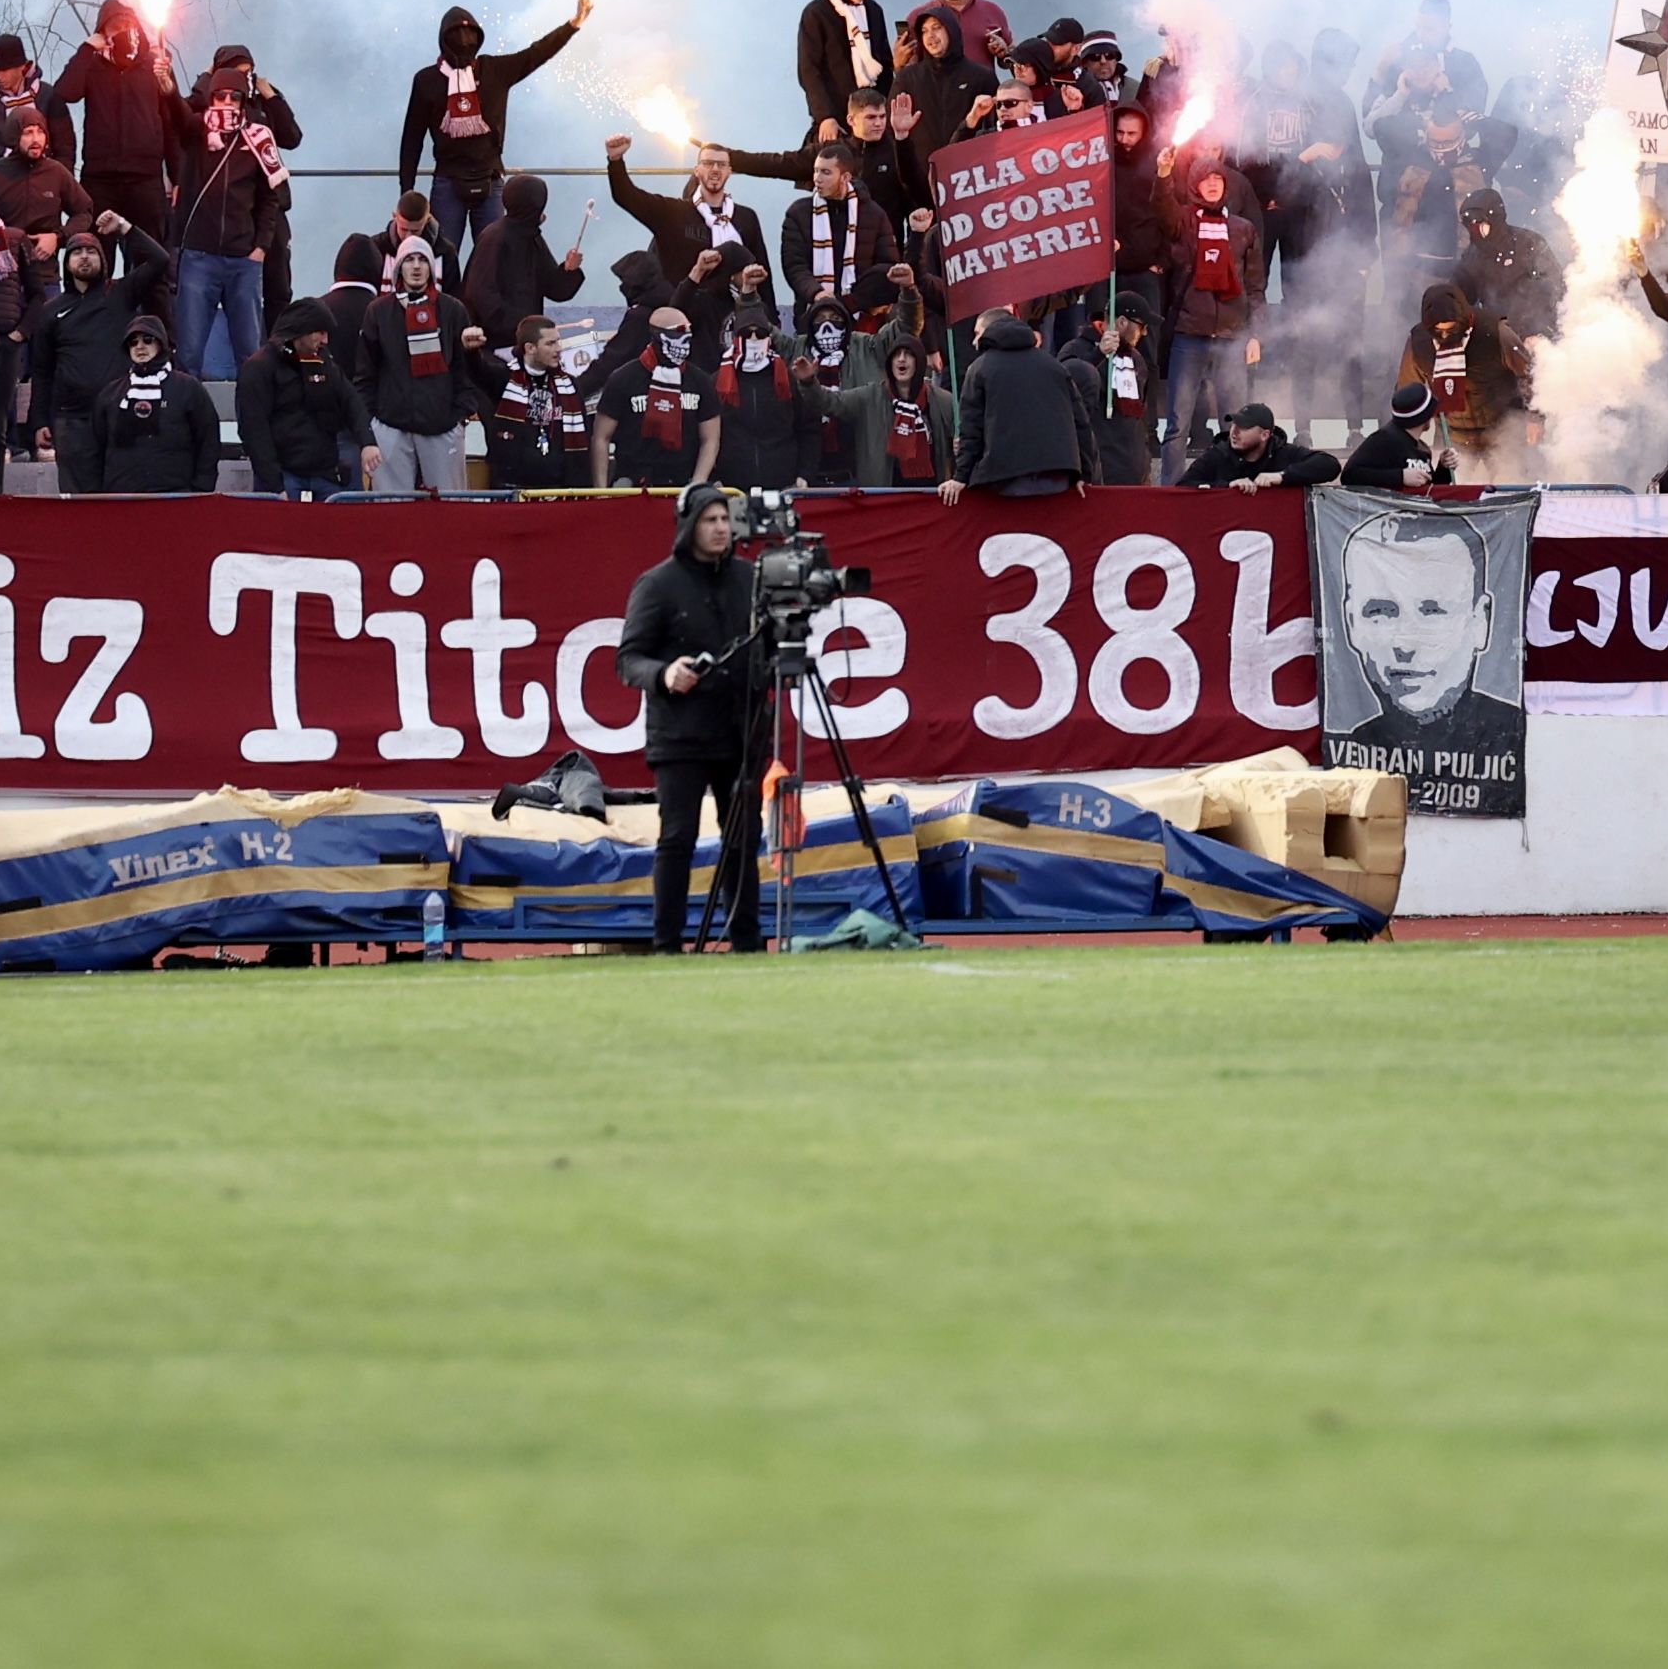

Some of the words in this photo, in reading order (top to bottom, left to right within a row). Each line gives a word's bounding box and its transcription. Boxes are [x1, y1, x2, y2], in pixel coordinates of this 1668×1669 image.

[951, 157, 1026, 201] ZLA
[1031, 135, 1110, 175] OCA
[980, 179, 1095, 230] GORE
[945, 217, 1102, 286] MATERE!
[208, 550, 910, 763] Titoe
[1329, 739, 1424, 774] VEDRAN
[1434, 750, 1516, 782] PULJIĆ
[1058, 792, 1113, 829] H-3
[1410, 781, 1481, 809] -2009
[240, 831, 294, 861] H-2
